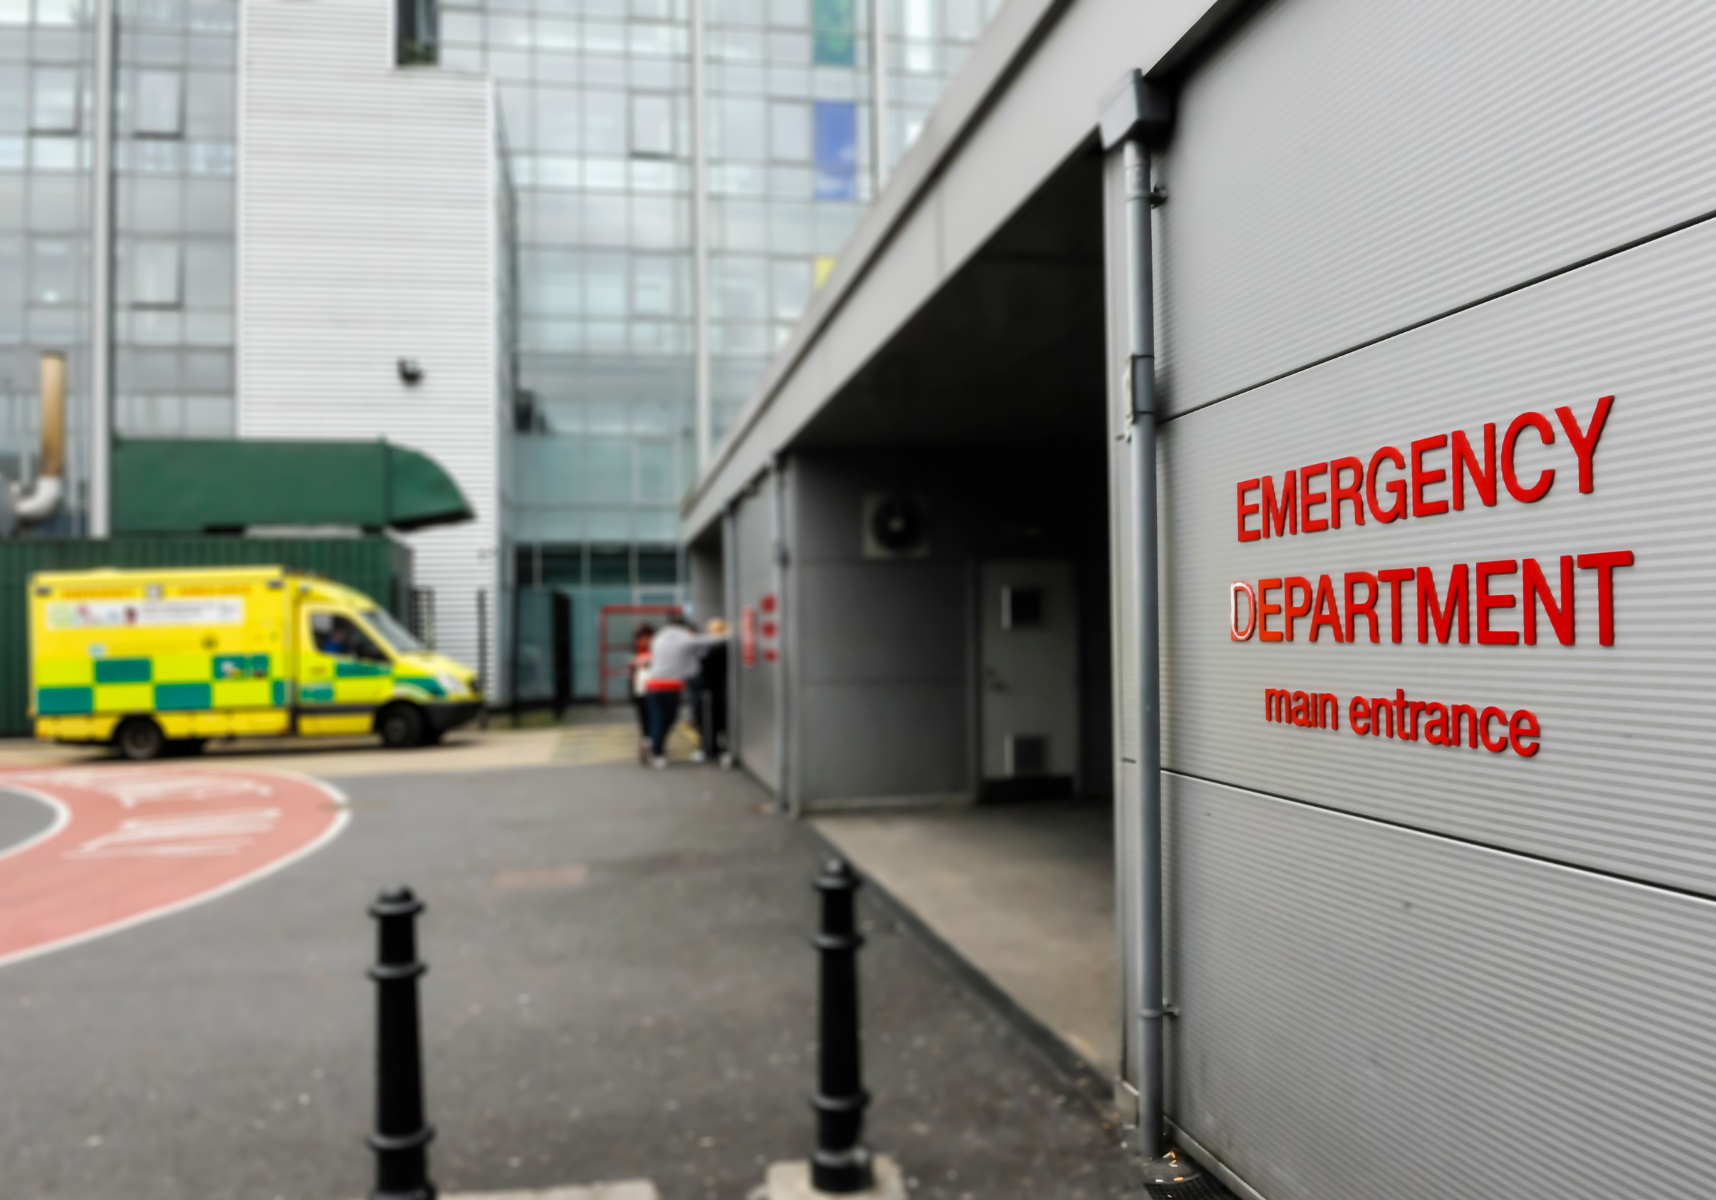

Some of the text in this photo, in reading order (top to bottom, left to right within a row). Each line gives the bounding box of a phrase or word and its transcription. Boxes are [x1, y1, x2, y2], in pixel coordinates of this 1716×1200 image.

[1236, 395, 1615, 543] EMERGENCY
[1230, 550, 1634, 647] DEPARTMENT
[1265, 687, 1541, 758] main entrance
